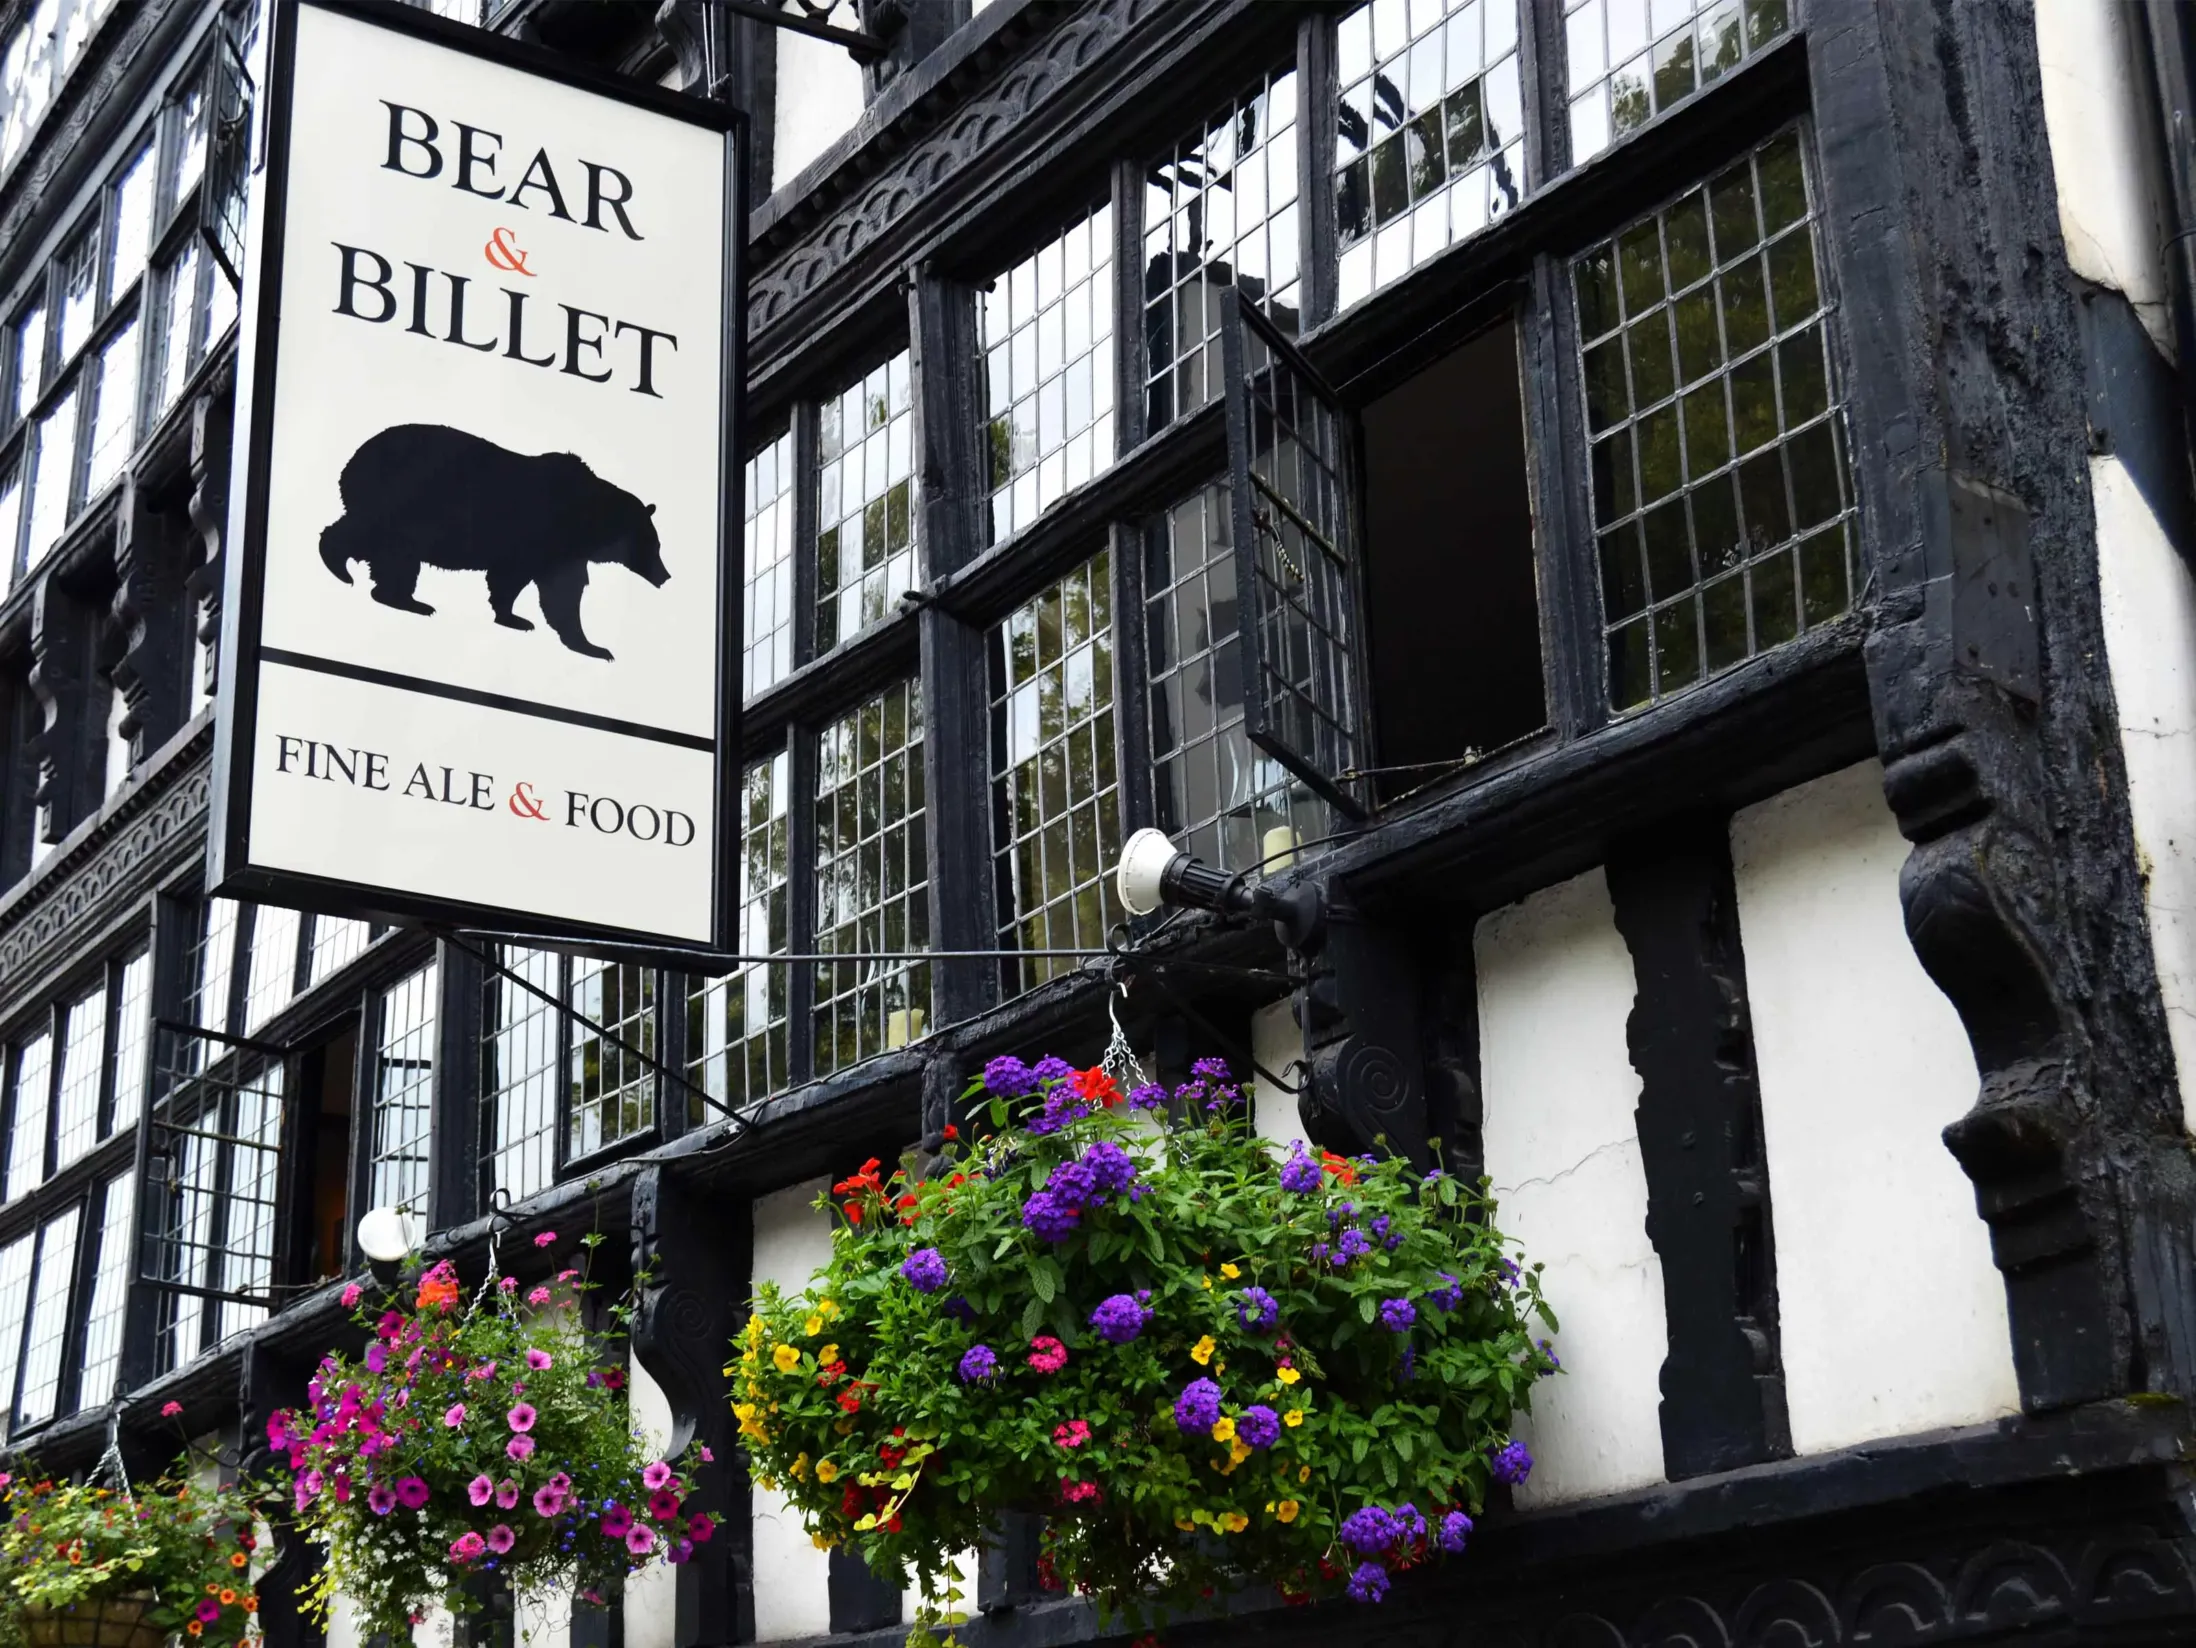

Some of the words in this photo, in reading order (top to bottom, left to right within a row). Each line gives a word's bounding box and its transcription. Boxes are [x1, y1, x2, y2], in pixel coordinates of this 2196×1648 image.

[379, 99, 645, 241] BEAR
[484, 227, 537, 277] &
[330, 241, 678, 399] BILLET
[276, 735, 390, 791] FINE
[402, 762, 495, 811] ALE
[509, 782, 550, 821] &
[565, 790, 696, 847] FOOD
